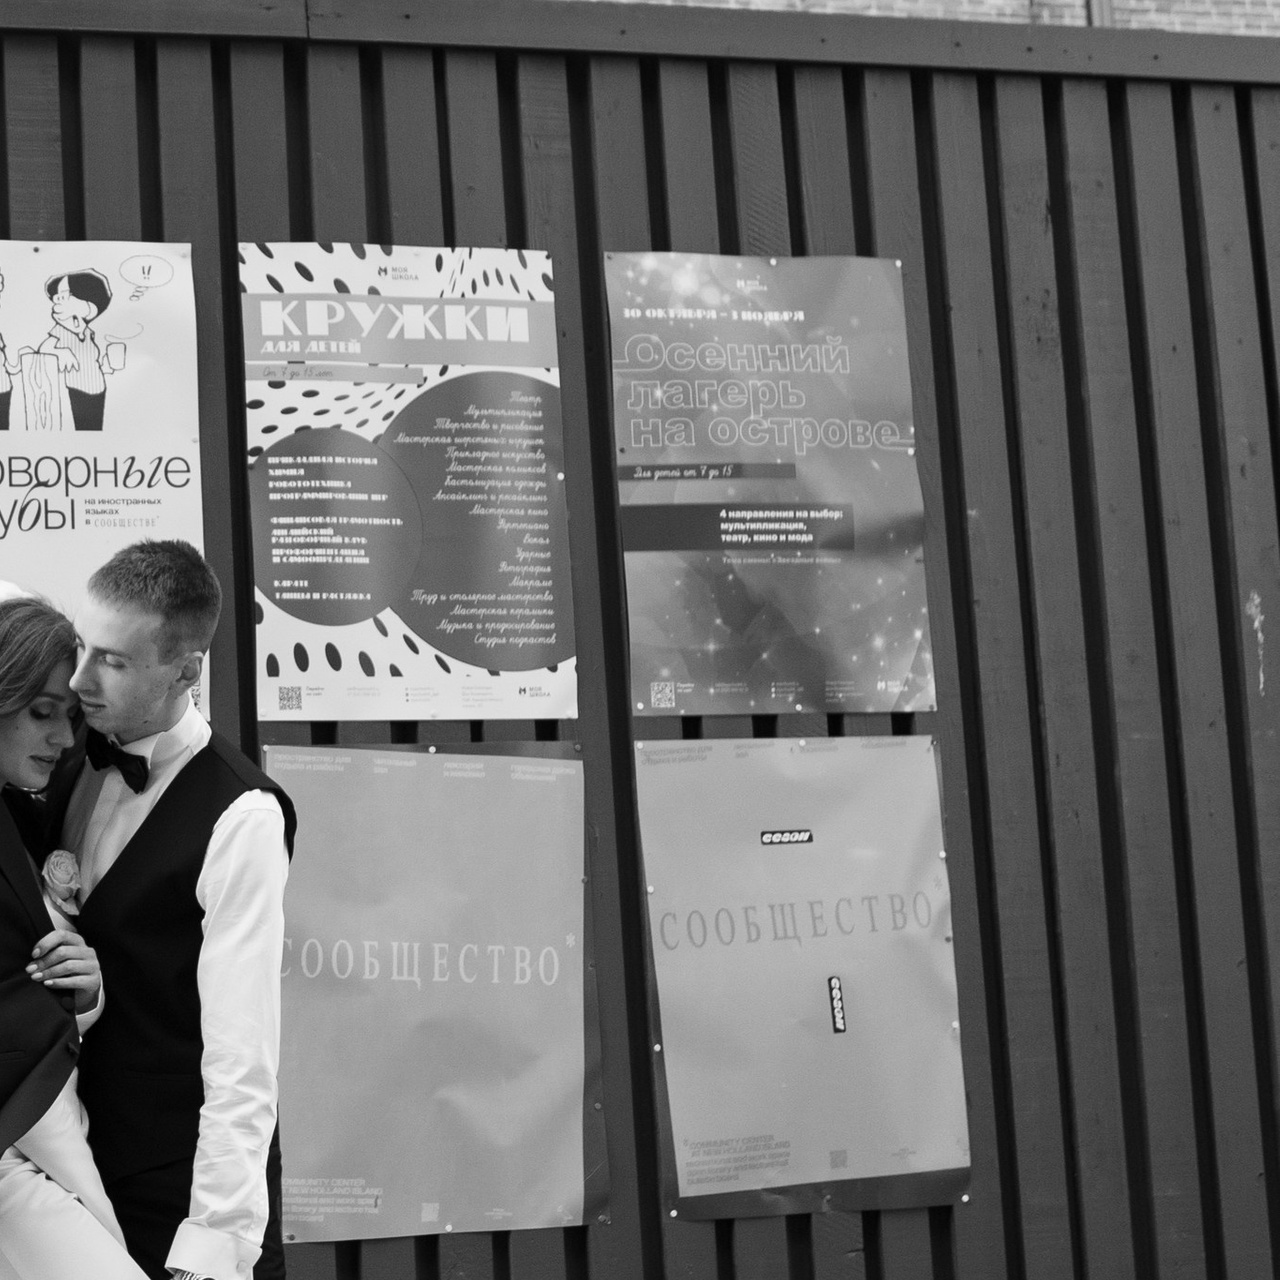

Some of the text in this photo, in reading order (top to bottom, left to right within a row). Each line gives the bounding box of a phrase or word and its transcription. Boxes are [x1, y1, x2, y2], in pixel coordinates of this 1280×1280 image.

[260, 299, 530, 343] КРУЖКИ
[261, 338, 362, 354] ДЛЯ ДЕТЕЙ
[612, 333, 851, 374] Осенний
[627, 379, 807, 417] лагерь
[631, 417, 916, 456] на острове
[98, 498, 162, 506] иностранных
[720, 508, 844, 521] 4 направления на выбор:
[720, 522, 807, 532] мультипликация,
[721, 533, 751, 544] театр,
[753, 533, 778, 542] кино
[788, 533, 814, 543] мода
[659, 890, 933, 952] СООБЩЕСТВО
